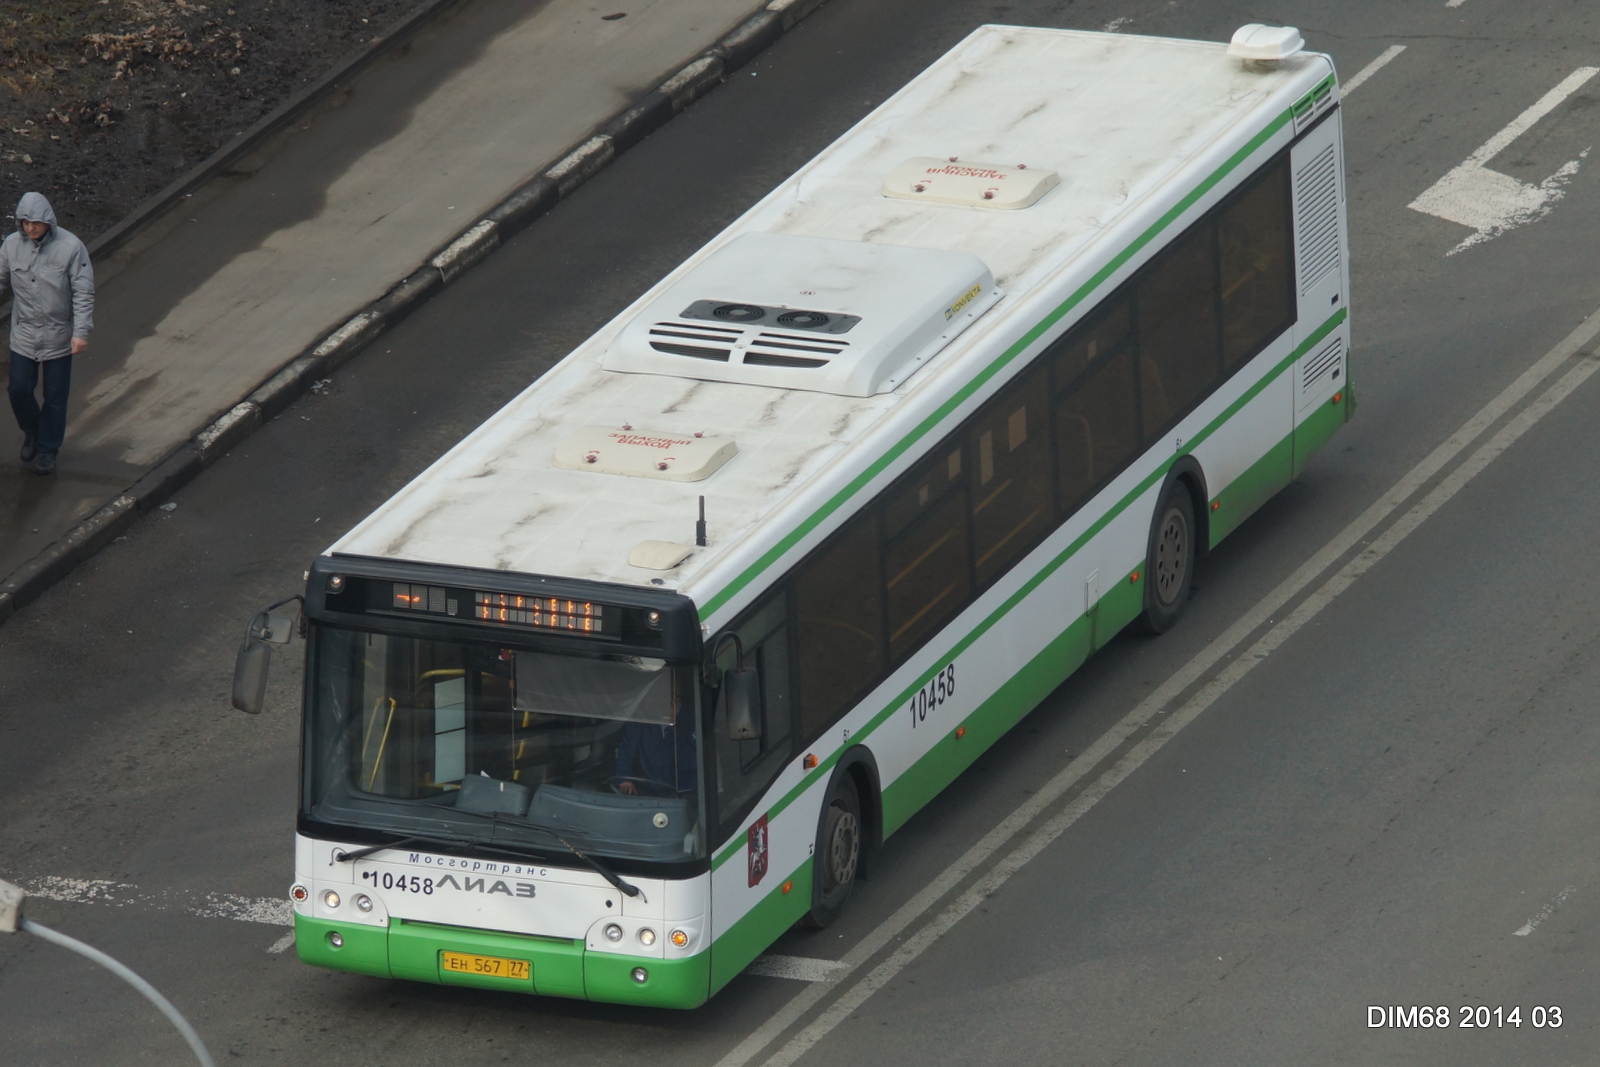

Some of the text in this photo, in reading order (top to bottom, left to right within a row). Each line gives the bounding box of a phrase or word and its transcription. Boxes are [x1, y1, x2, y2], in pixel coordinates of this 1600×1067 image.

[951, 285, 981, 314] KONVEKTA
[608, 433, 692, 446] ЗАПАСНЫЙ
[617, 438, 672, 450] ВЫХОД
[909, 663, 955, 729] 10458
[409, 852, 547, 877] Мосгортранс
[369, 870, 434, 895] 10458
[435, 874, 536, 899] ЛИАЗ
[474, 958, 501, 974] 567
[510, 961, 524, 973] 77
